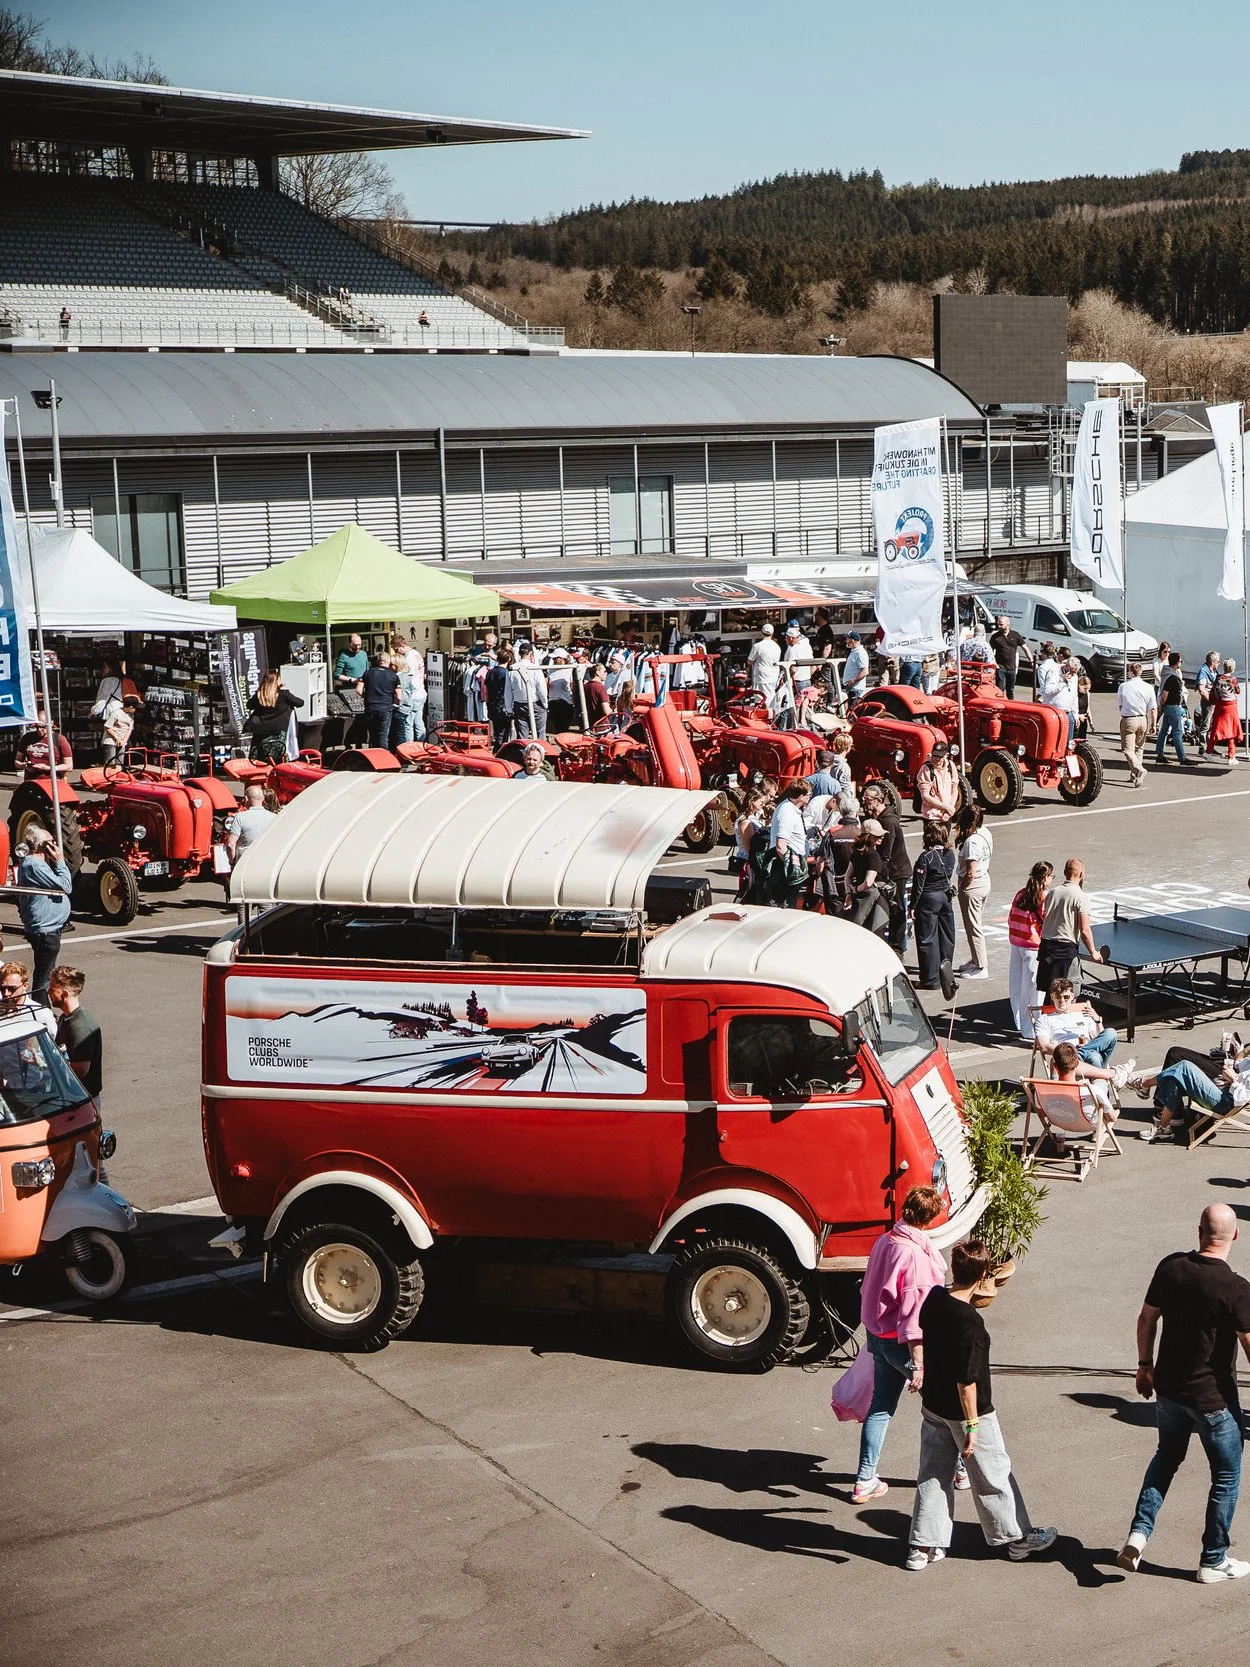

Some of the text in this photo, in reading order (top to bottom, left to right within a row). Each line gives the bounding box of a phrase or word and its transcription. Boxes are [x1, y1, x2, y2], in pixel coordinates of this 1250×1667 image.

[1143, 963, 1162, 971] JOOLA
[1081, 989, 1100, 999] JOOLA
[248, 1037, 291, 1047] PORSCHE
[248, 1047, 279, 1057] CLUBS
[249, 1057, 308, 1068] WORLDWIDE
